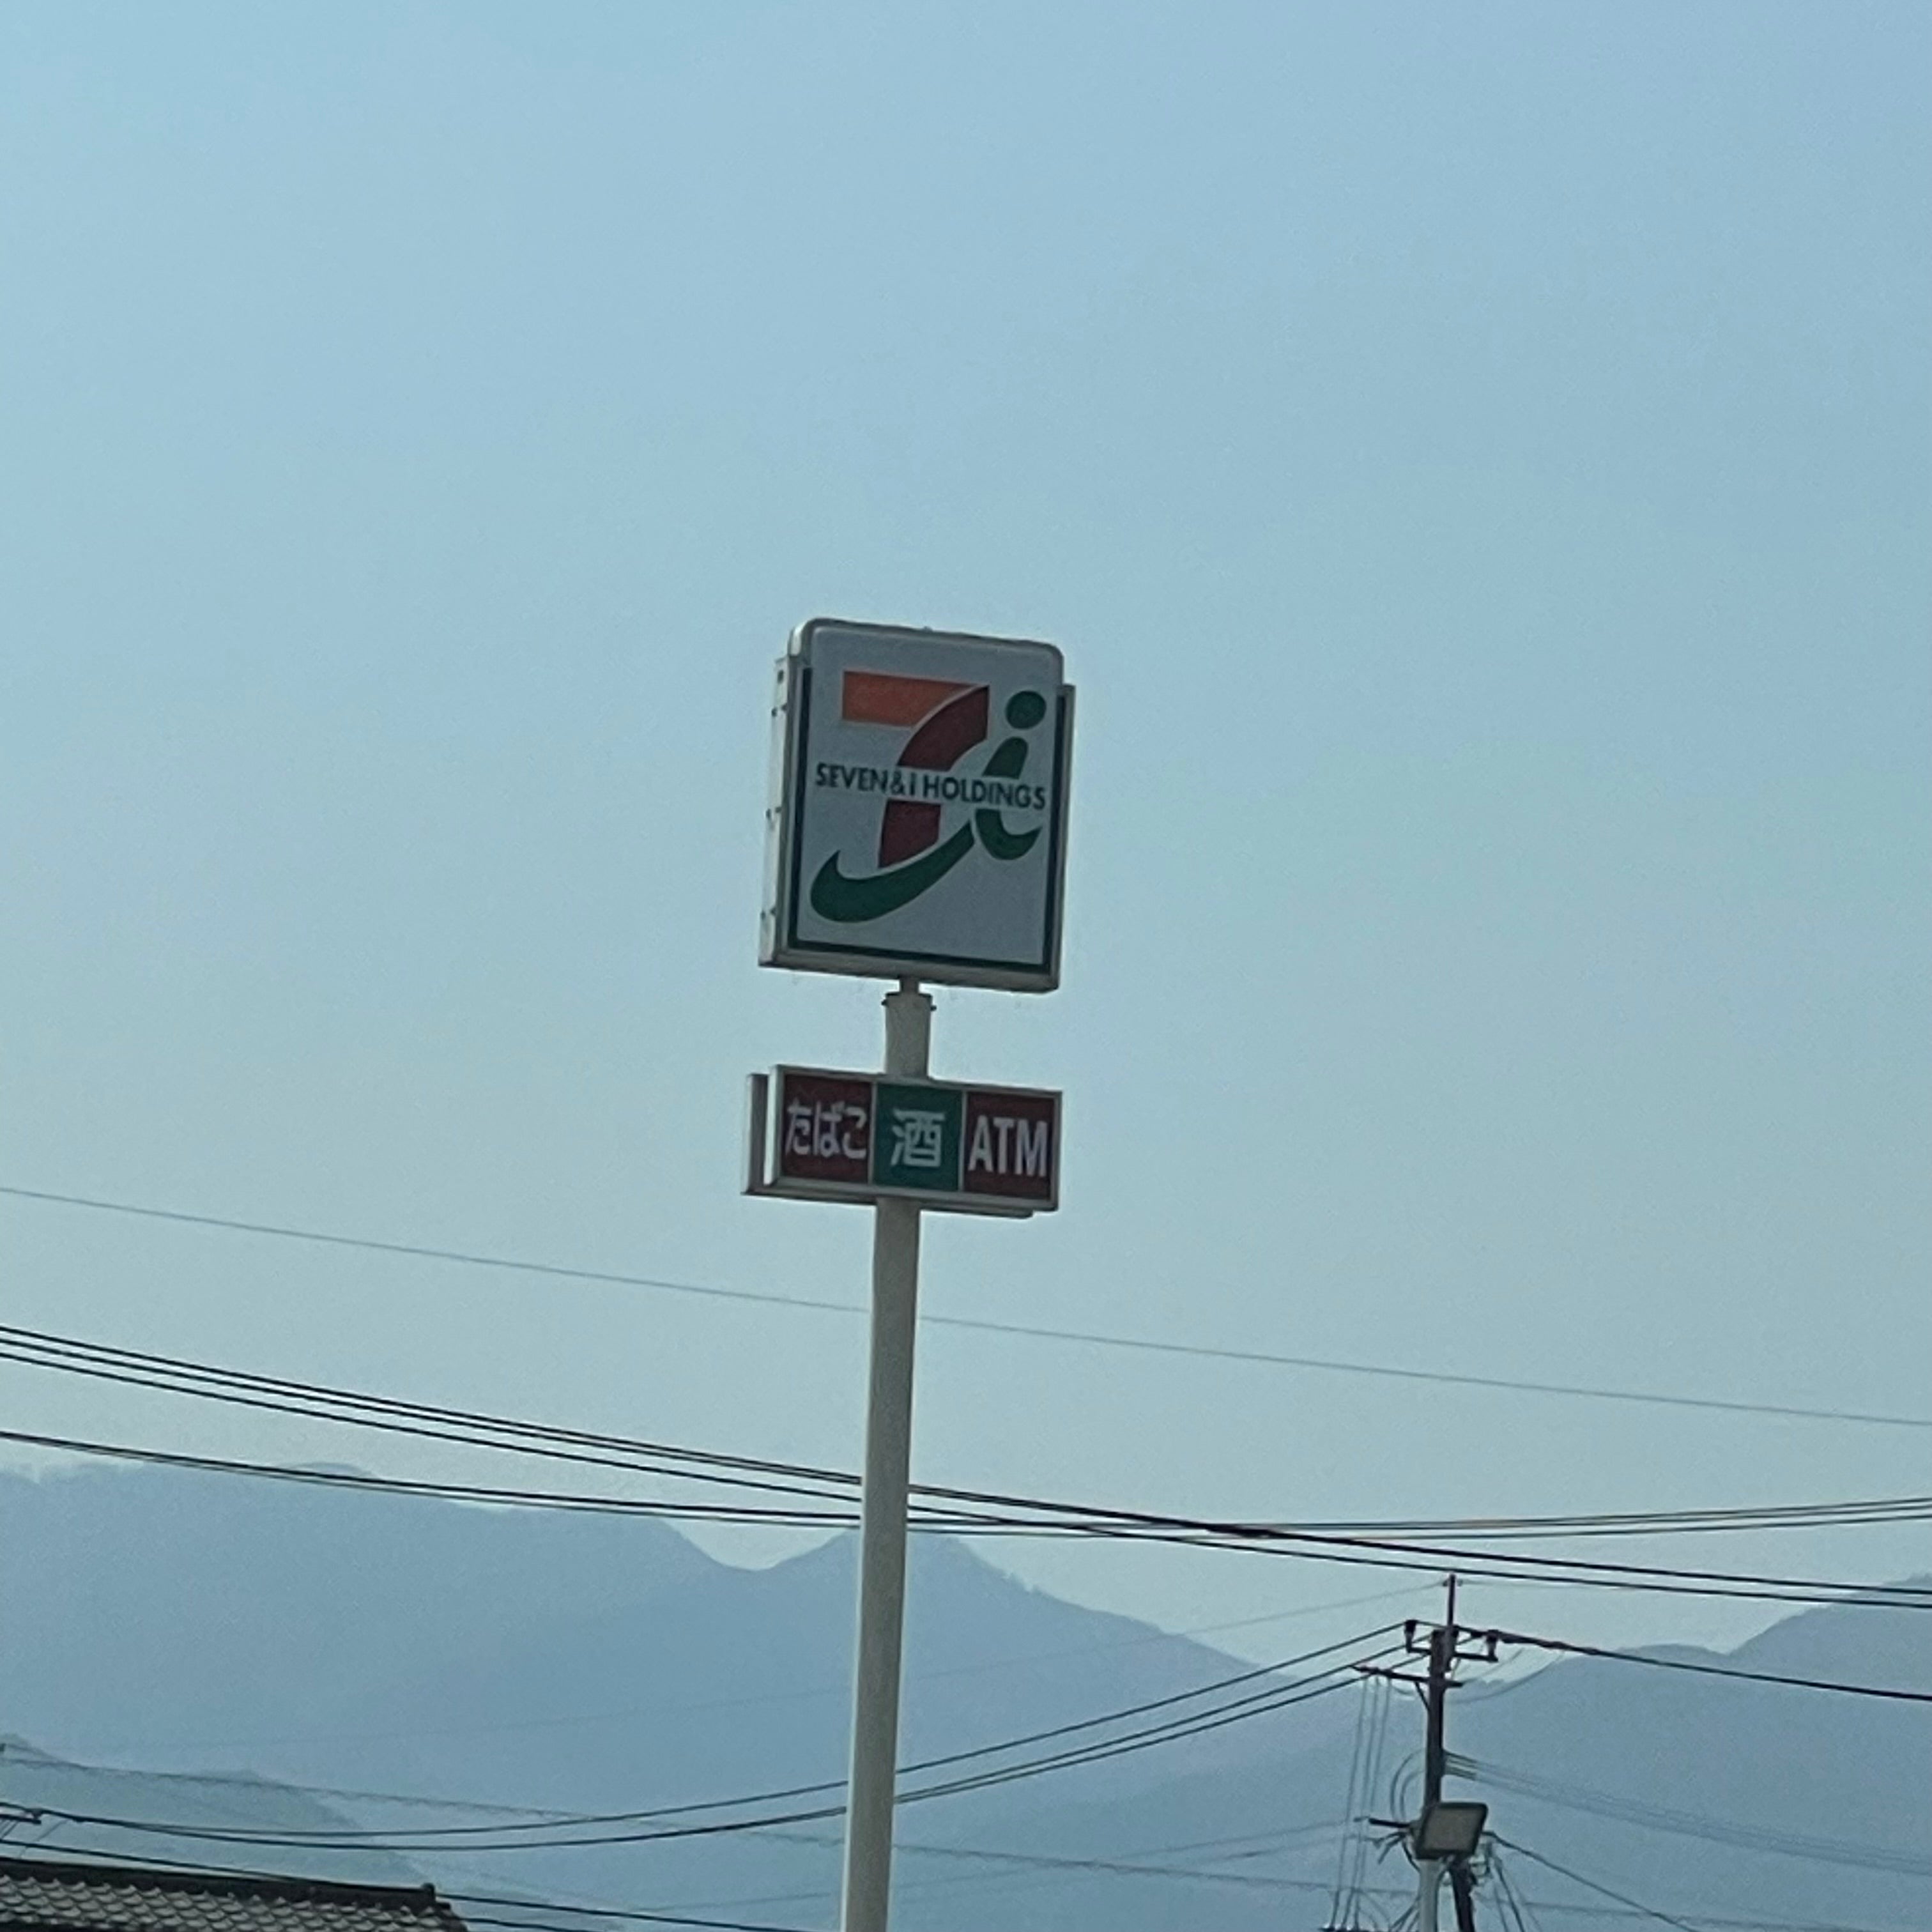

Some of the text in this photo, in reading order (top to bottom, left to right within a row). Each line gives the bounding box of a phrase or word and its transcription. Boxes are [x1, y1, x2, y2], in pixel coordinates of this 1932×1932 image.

[923, 775, 1046, 811] HOLDINGS
[785, 1097, 868, 1160] たばこ
[891, 1108, 946, 1168] 酒
[967, 1114, 1049, 1177] ATM
